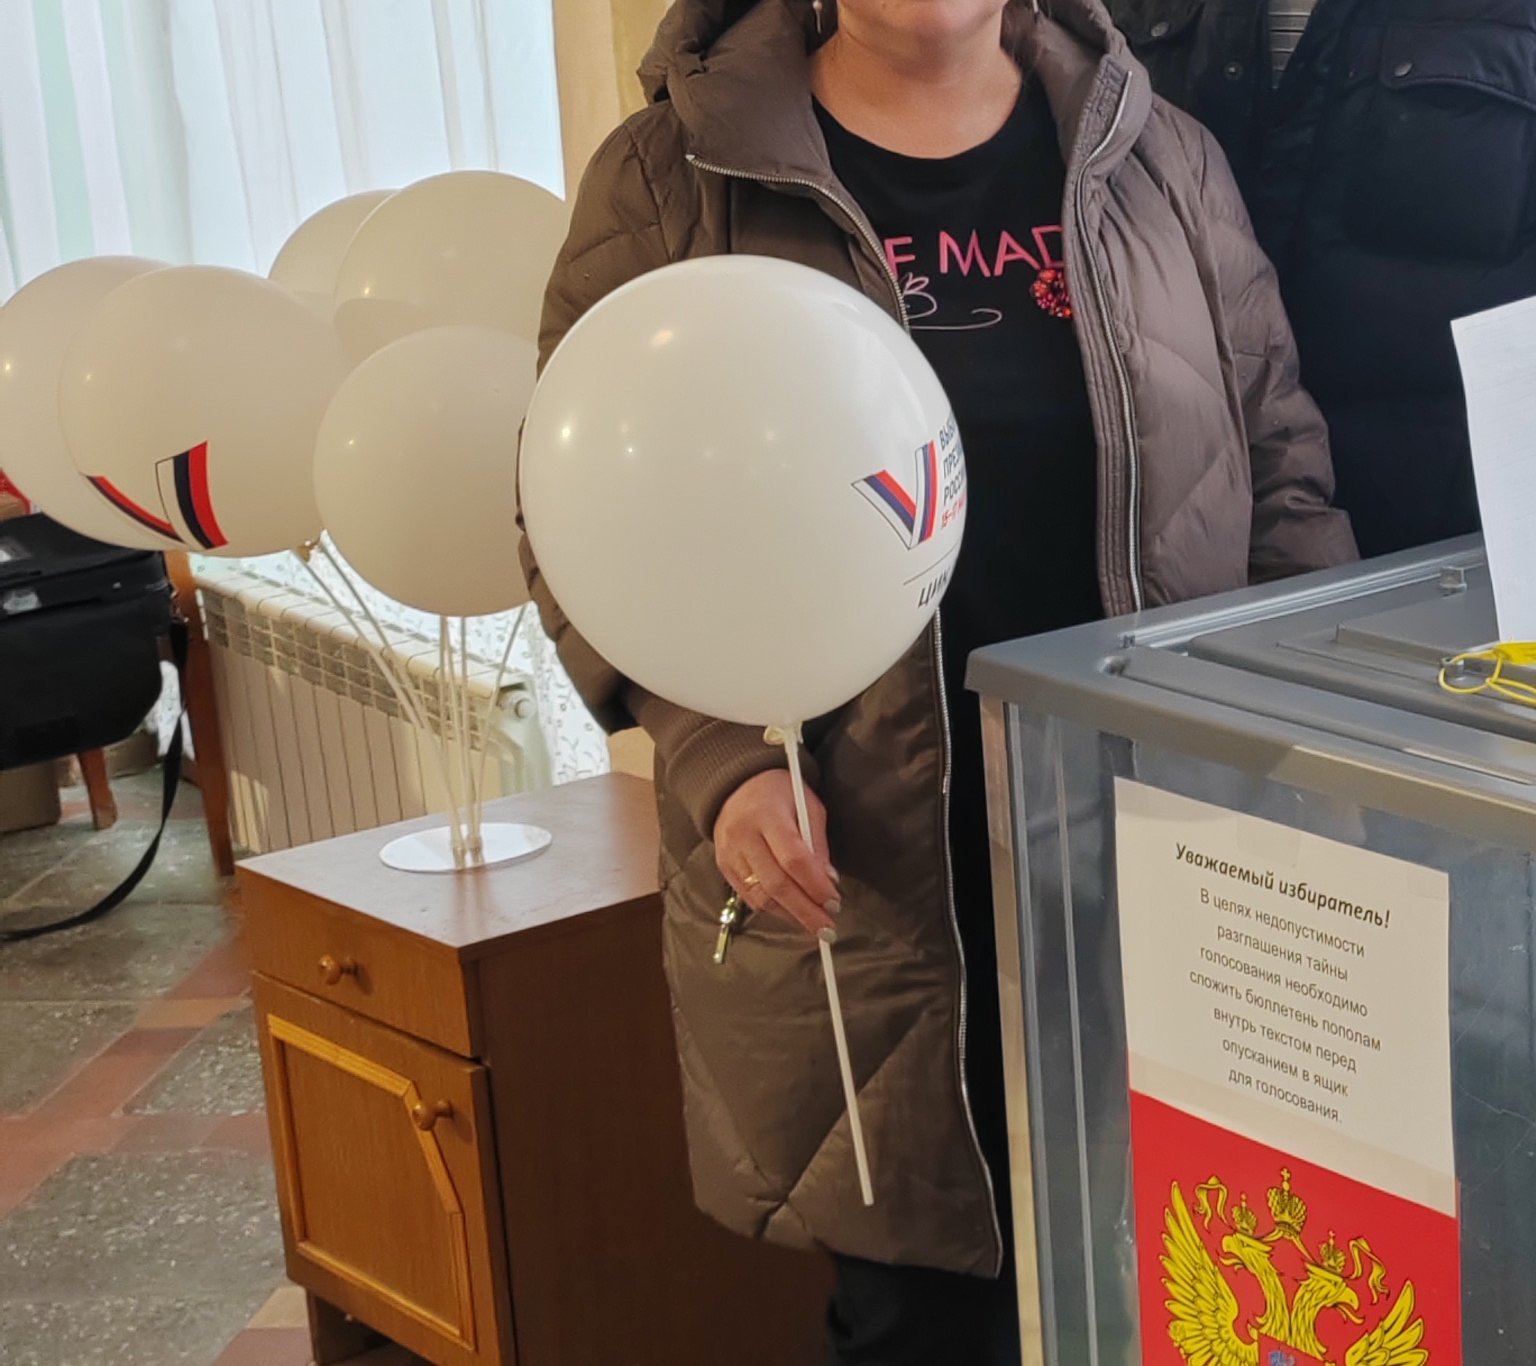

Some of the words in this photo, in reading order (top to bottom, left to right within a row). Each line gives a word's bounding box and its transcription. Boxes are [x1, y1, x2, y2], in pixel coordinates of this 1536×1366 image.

[1176, 842, 1275, 891] Уважаемый
[1279, 882, 1391, 929] избиратель!
[1200, 887, 1210, 904] В
[1213, 894, 1252, 919] целях
[1255, 909, 1366, 958] недопустимости
[1217, 924, 1302, 966] разглашения
[1306, 954, 1349, 982] тайны
[1189, 970, 1242, 1001] сложить
[1245, 988, 1319, 1029] бюллетень
[1322, 1019, 1382, 1051] пополам
[1199, 946, 1281, 986] голосования
[1285, 976, 1368, 1018] необходимо
[1213, 1007, 1257, 1034] внутрь
[1260, 1024, 1312, 1055] текстом
[1315, 1045, 1357, 1074] перед
[1222, 1038, 1299, 1078] опусканием
[1302, 1068, 1310, 1082] в
[1313, 1073, 1349, 1097] ящик
[1228, 1068, 1252, 1088] для
[1255, 1078, 1343, 1124] голосования.
